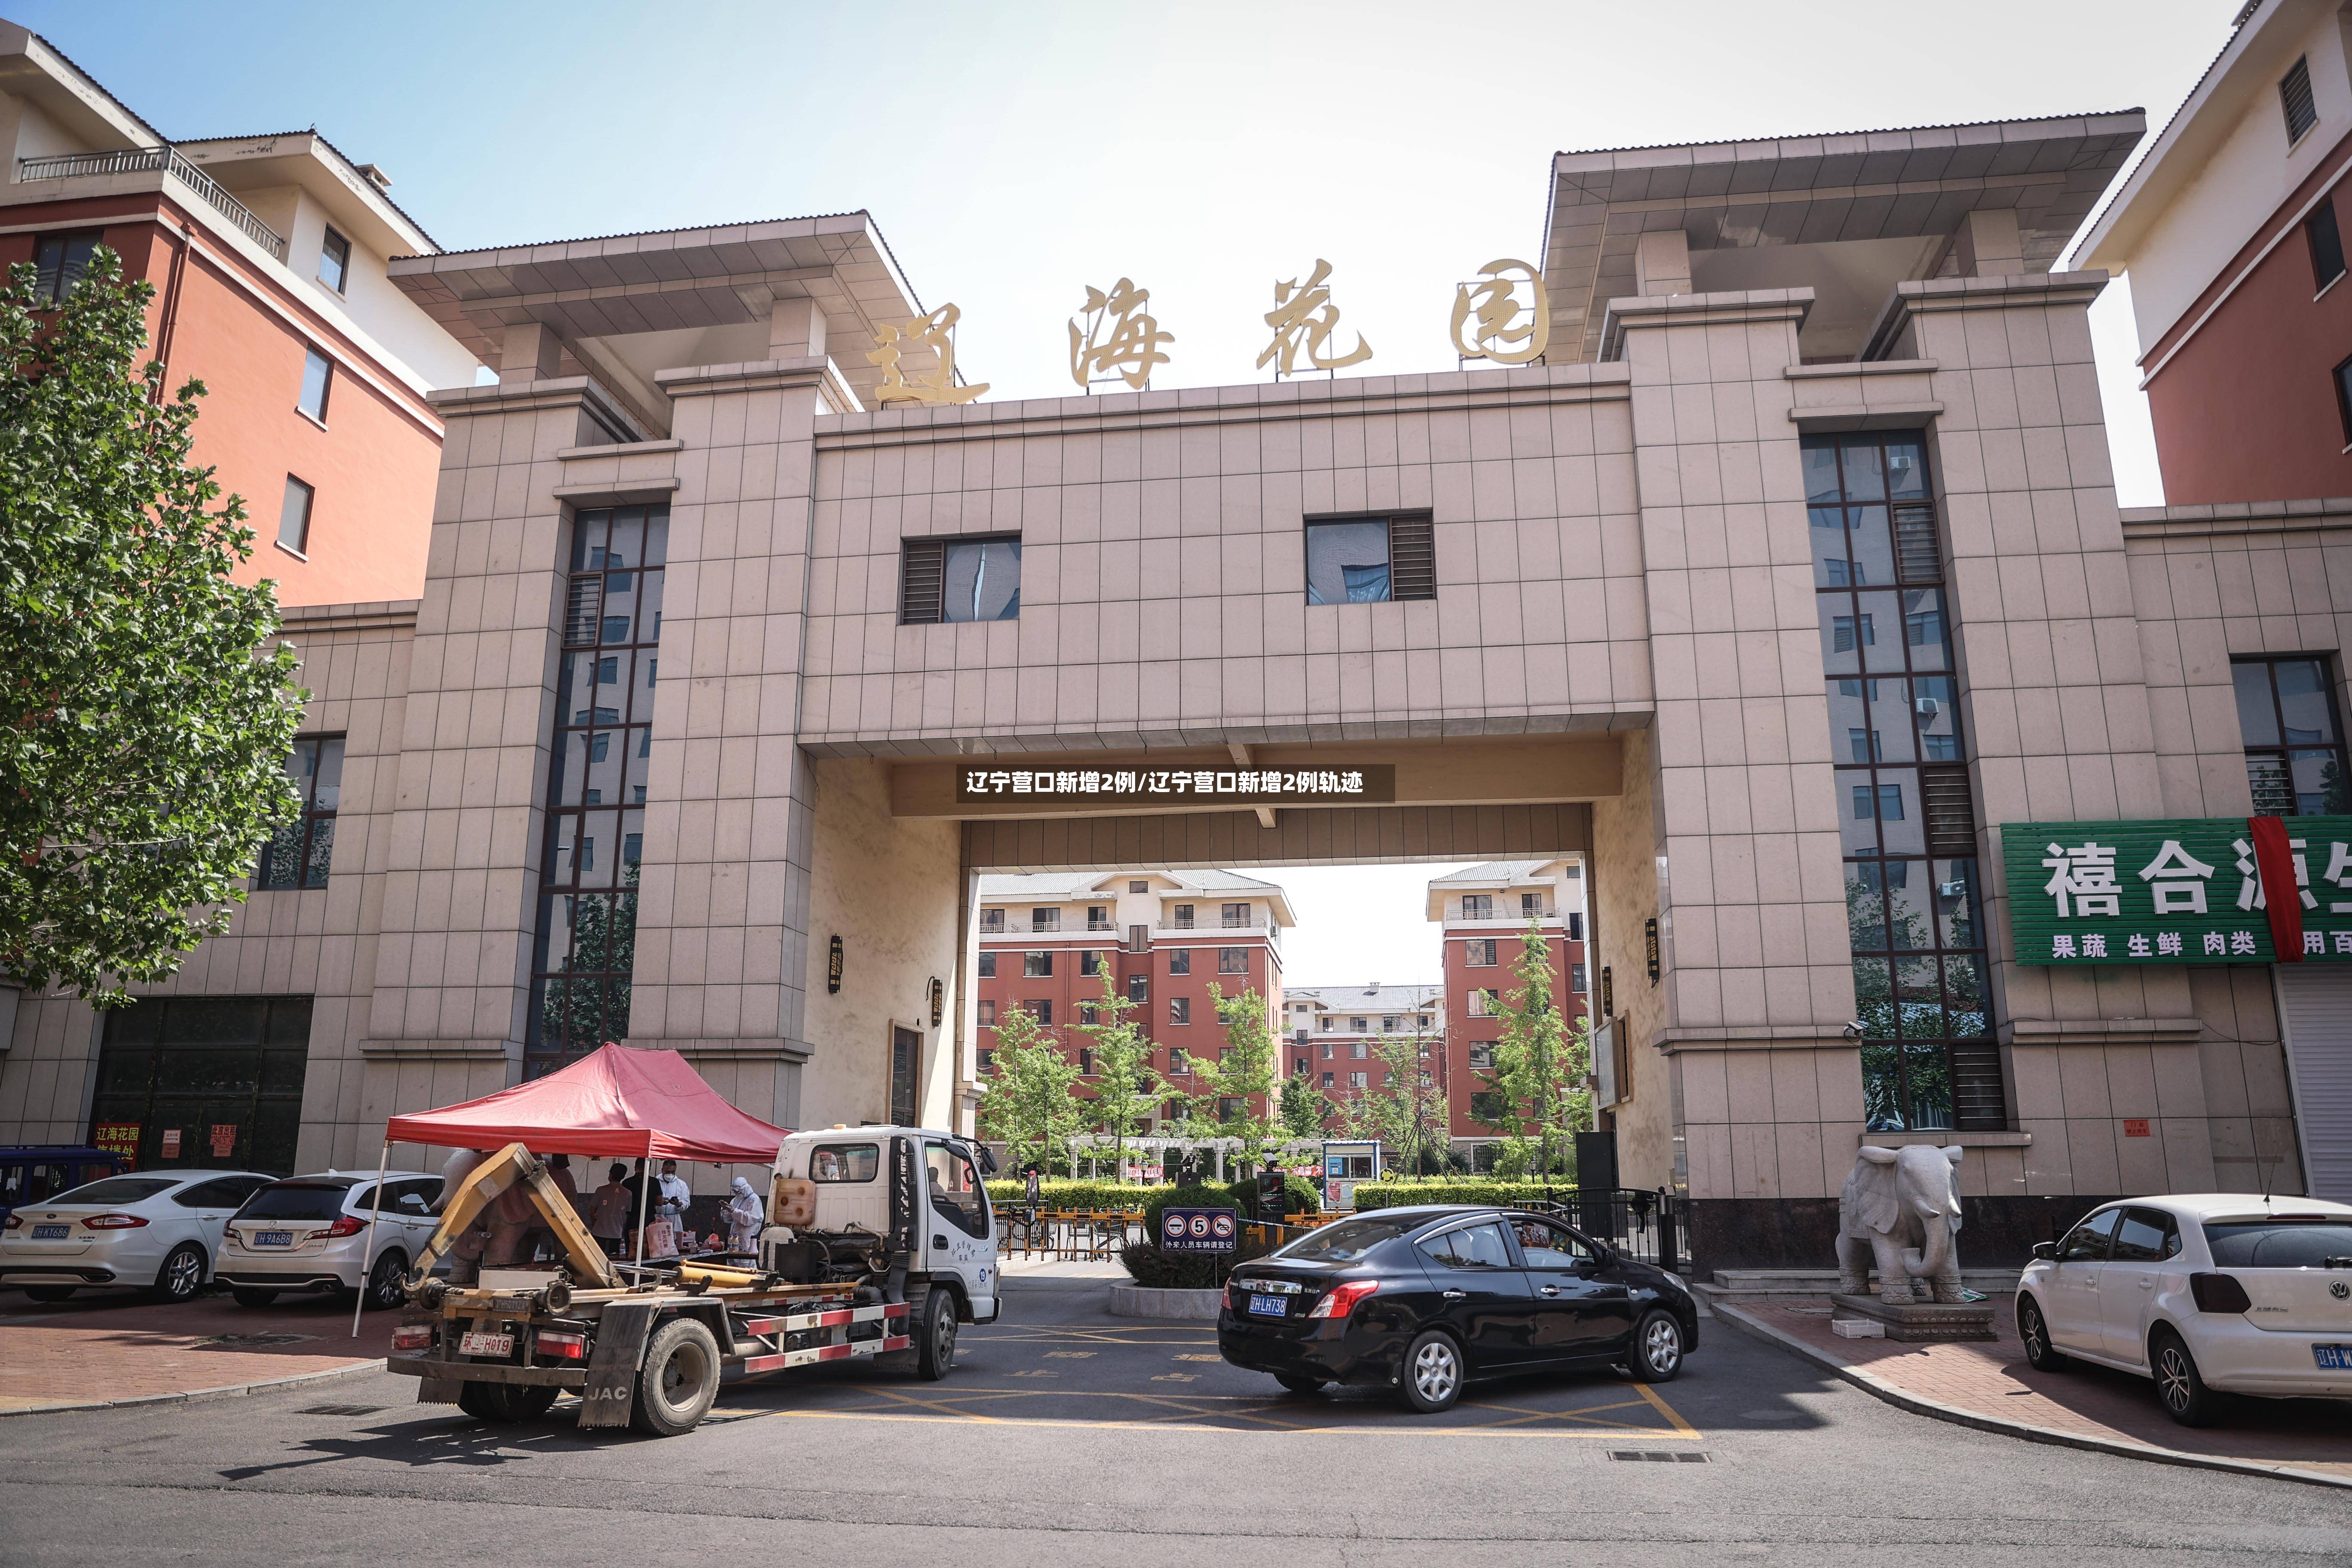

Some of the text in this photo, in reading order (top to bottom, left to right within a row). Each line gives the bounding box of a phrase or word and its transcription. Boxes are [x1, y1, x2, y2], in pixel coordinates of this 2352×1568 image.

[2052, 934, 2107, 959] 果蔬
[2127, 932, 2183, 957] 生鲜
[2203, 931, 2256, 955] 肉类
[96, 1127, 139, 1141] 辽海花园
[1195, 1220, 1204, 1233] 5
[980, 1271, 985, 1280] 19
[588, 1386, 627, 1400] JAC
